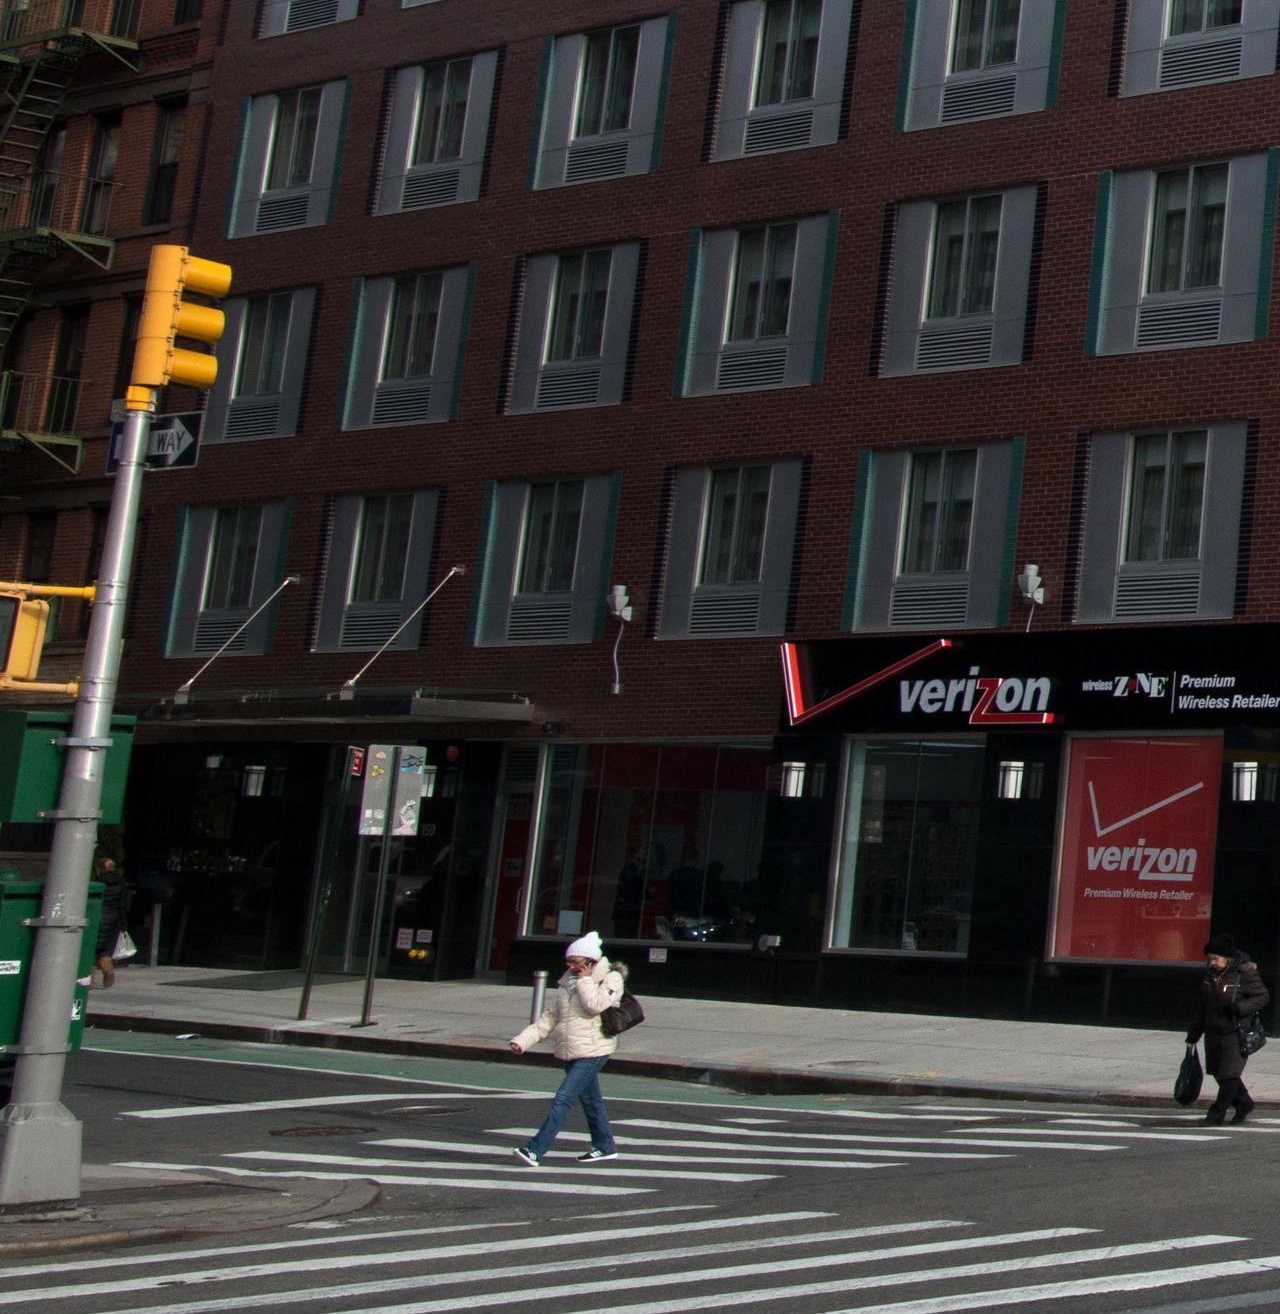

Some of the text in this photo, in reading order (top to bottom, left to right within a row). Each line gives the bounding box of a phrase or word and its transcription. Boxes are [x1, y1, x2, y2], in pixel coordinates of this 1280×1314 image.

[157, 430, 185, 453] WAY
[1082, 679, 1113, 692] wireless
[1180, 674, 1236, 688] Premium
[900, 665, 1055, 725] verizon
[1178, 695, 1230, 709] Wireless
[1086, 837, 1198, 882] verizon
[1083, 887, 1194, 901] Premium Wireless Retailer
